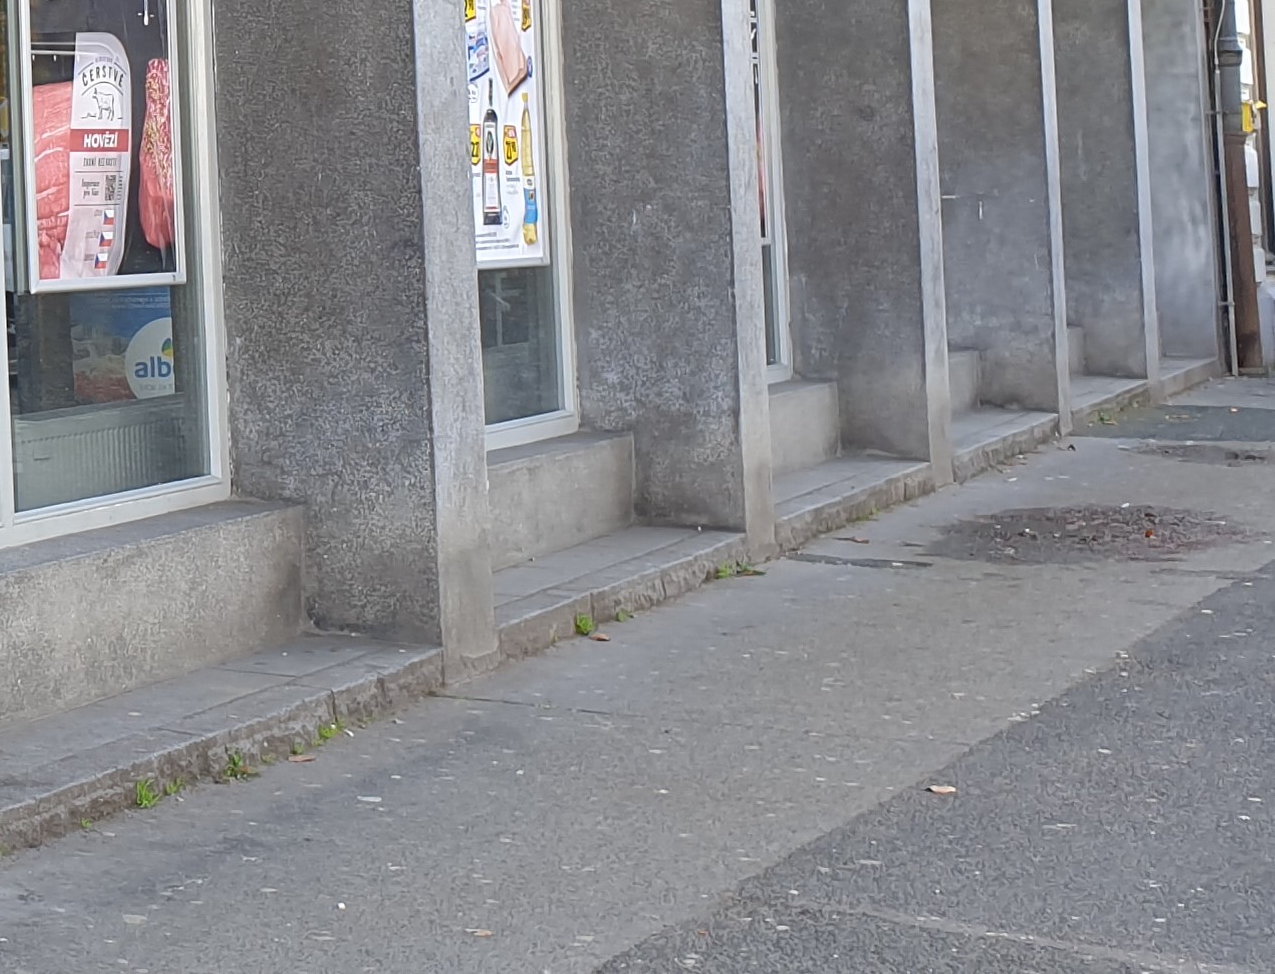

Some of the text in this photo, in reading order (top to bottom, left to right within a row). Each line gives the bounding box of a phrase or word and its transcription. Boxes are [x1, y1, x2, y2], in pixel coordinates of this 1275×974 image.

[81, 64, 124, 88] ČERSTVÉ
[83, 130, 119, 149] HOVĚZÍ
[133, 355, 175, 379] alb
